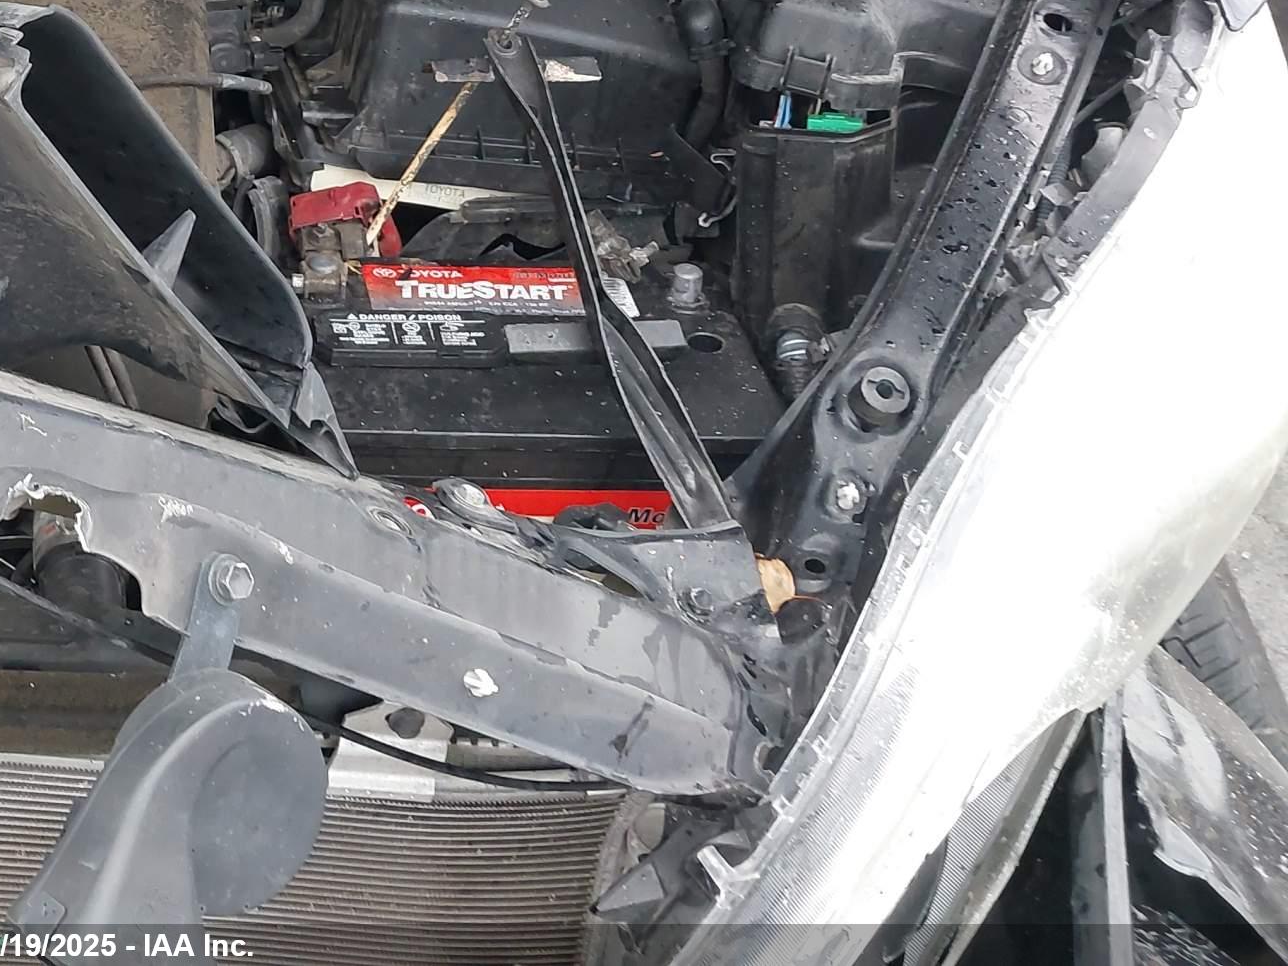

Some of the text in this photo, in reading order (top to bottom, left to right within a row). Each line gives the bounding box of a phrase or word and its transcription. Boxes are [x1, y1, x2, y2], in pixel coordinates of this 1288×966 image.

[425, 184, 465, 198] TOYOTA
[358, 313, 407, 321] DANGER
[418, 314, 463, 322] POISON
